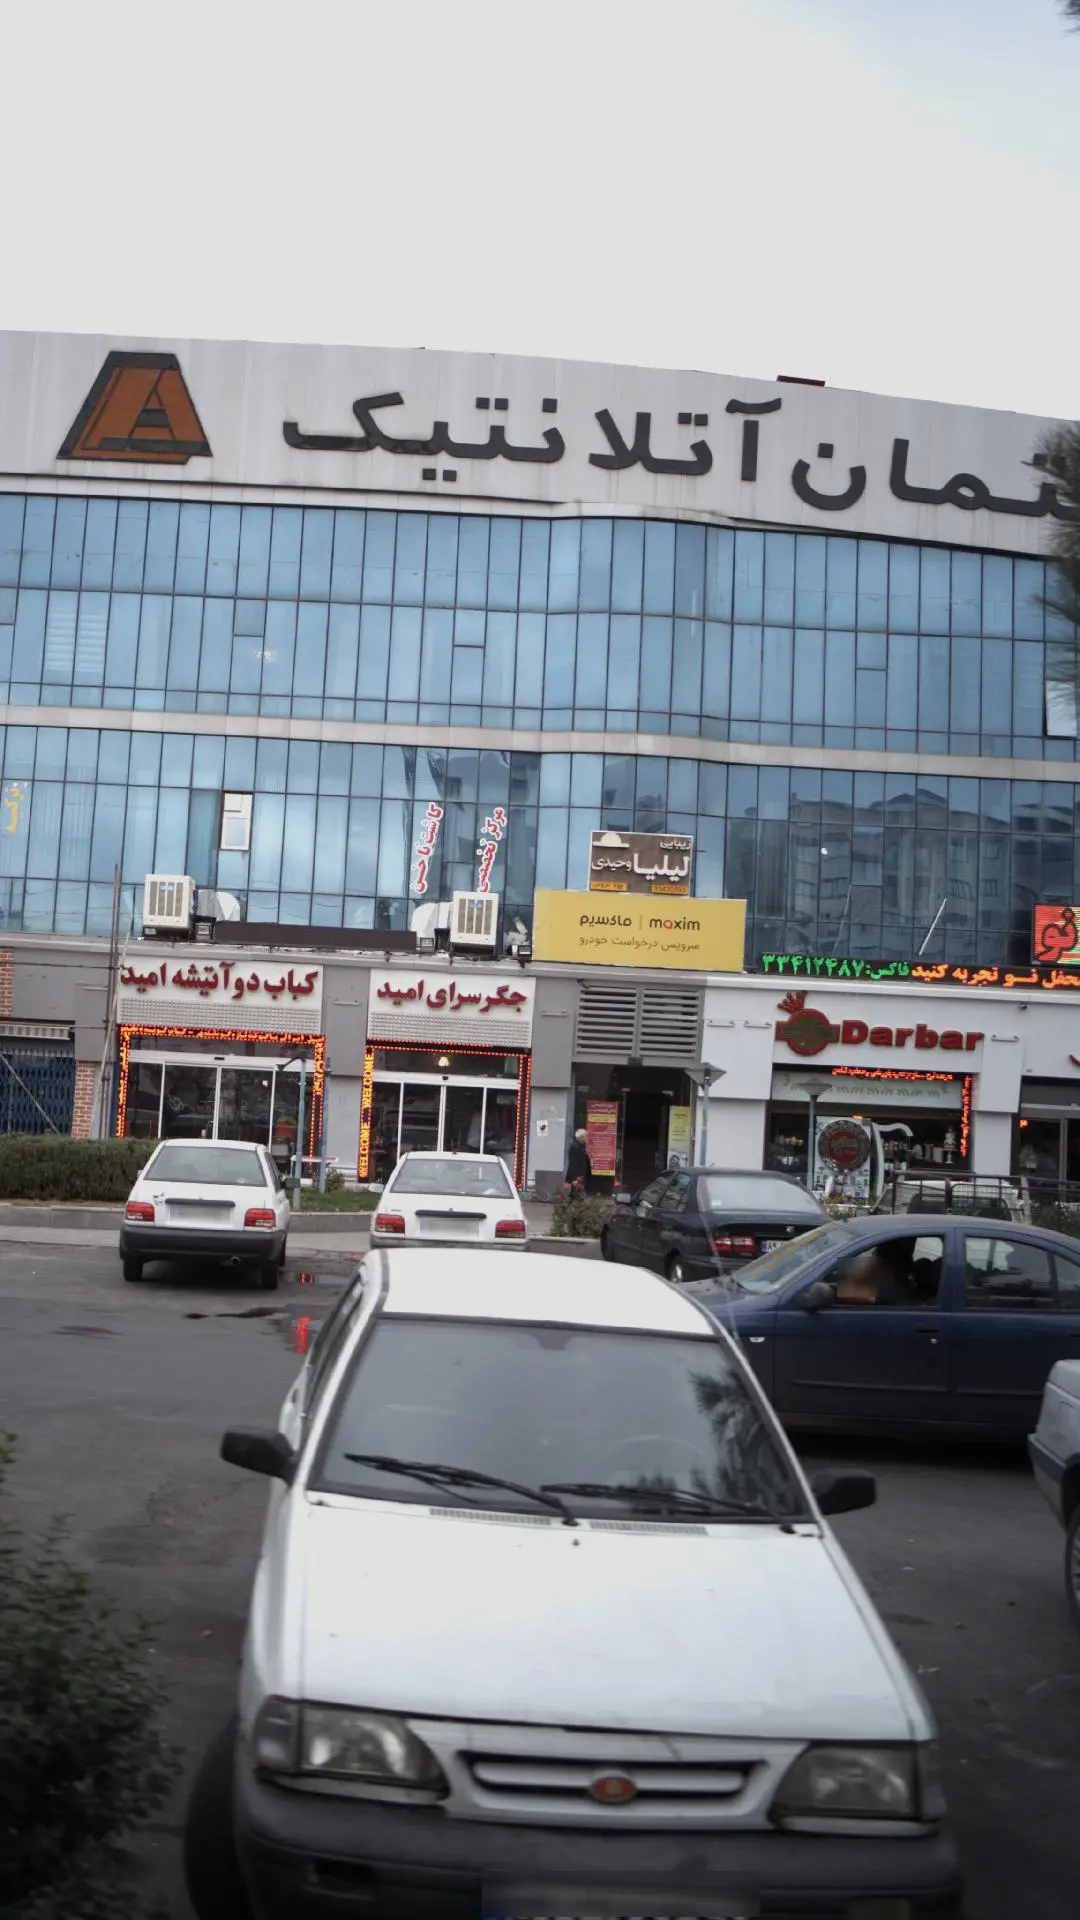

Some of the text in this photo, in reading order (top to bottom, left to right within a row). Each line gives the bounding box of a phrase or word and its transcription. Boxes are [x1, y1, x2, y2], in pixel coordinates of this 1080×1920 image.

[283, 391, 782, 482] آتلانتیک
[591, 852, 690, 882] لیلیا وحیدی
[579, 914, 633, 928] ماکسیم
[649, 916, 701, 931] maxim
[579, 934, 700, 952] سرویس درخواست خودرو
[119, 962, 168, 993] امید
[171, 960, 236, 997] آتیشه
[263, 968, 320, 1000] کباب
[911, 963, 949, 982] کنید
[952, 966, 999, 987] تجربه
[376, 979, 425, 1006] امید
[841, 1019, 985, 1051] Darbar
[358, 1053, 375, 1179] WELCOME WELCOME
